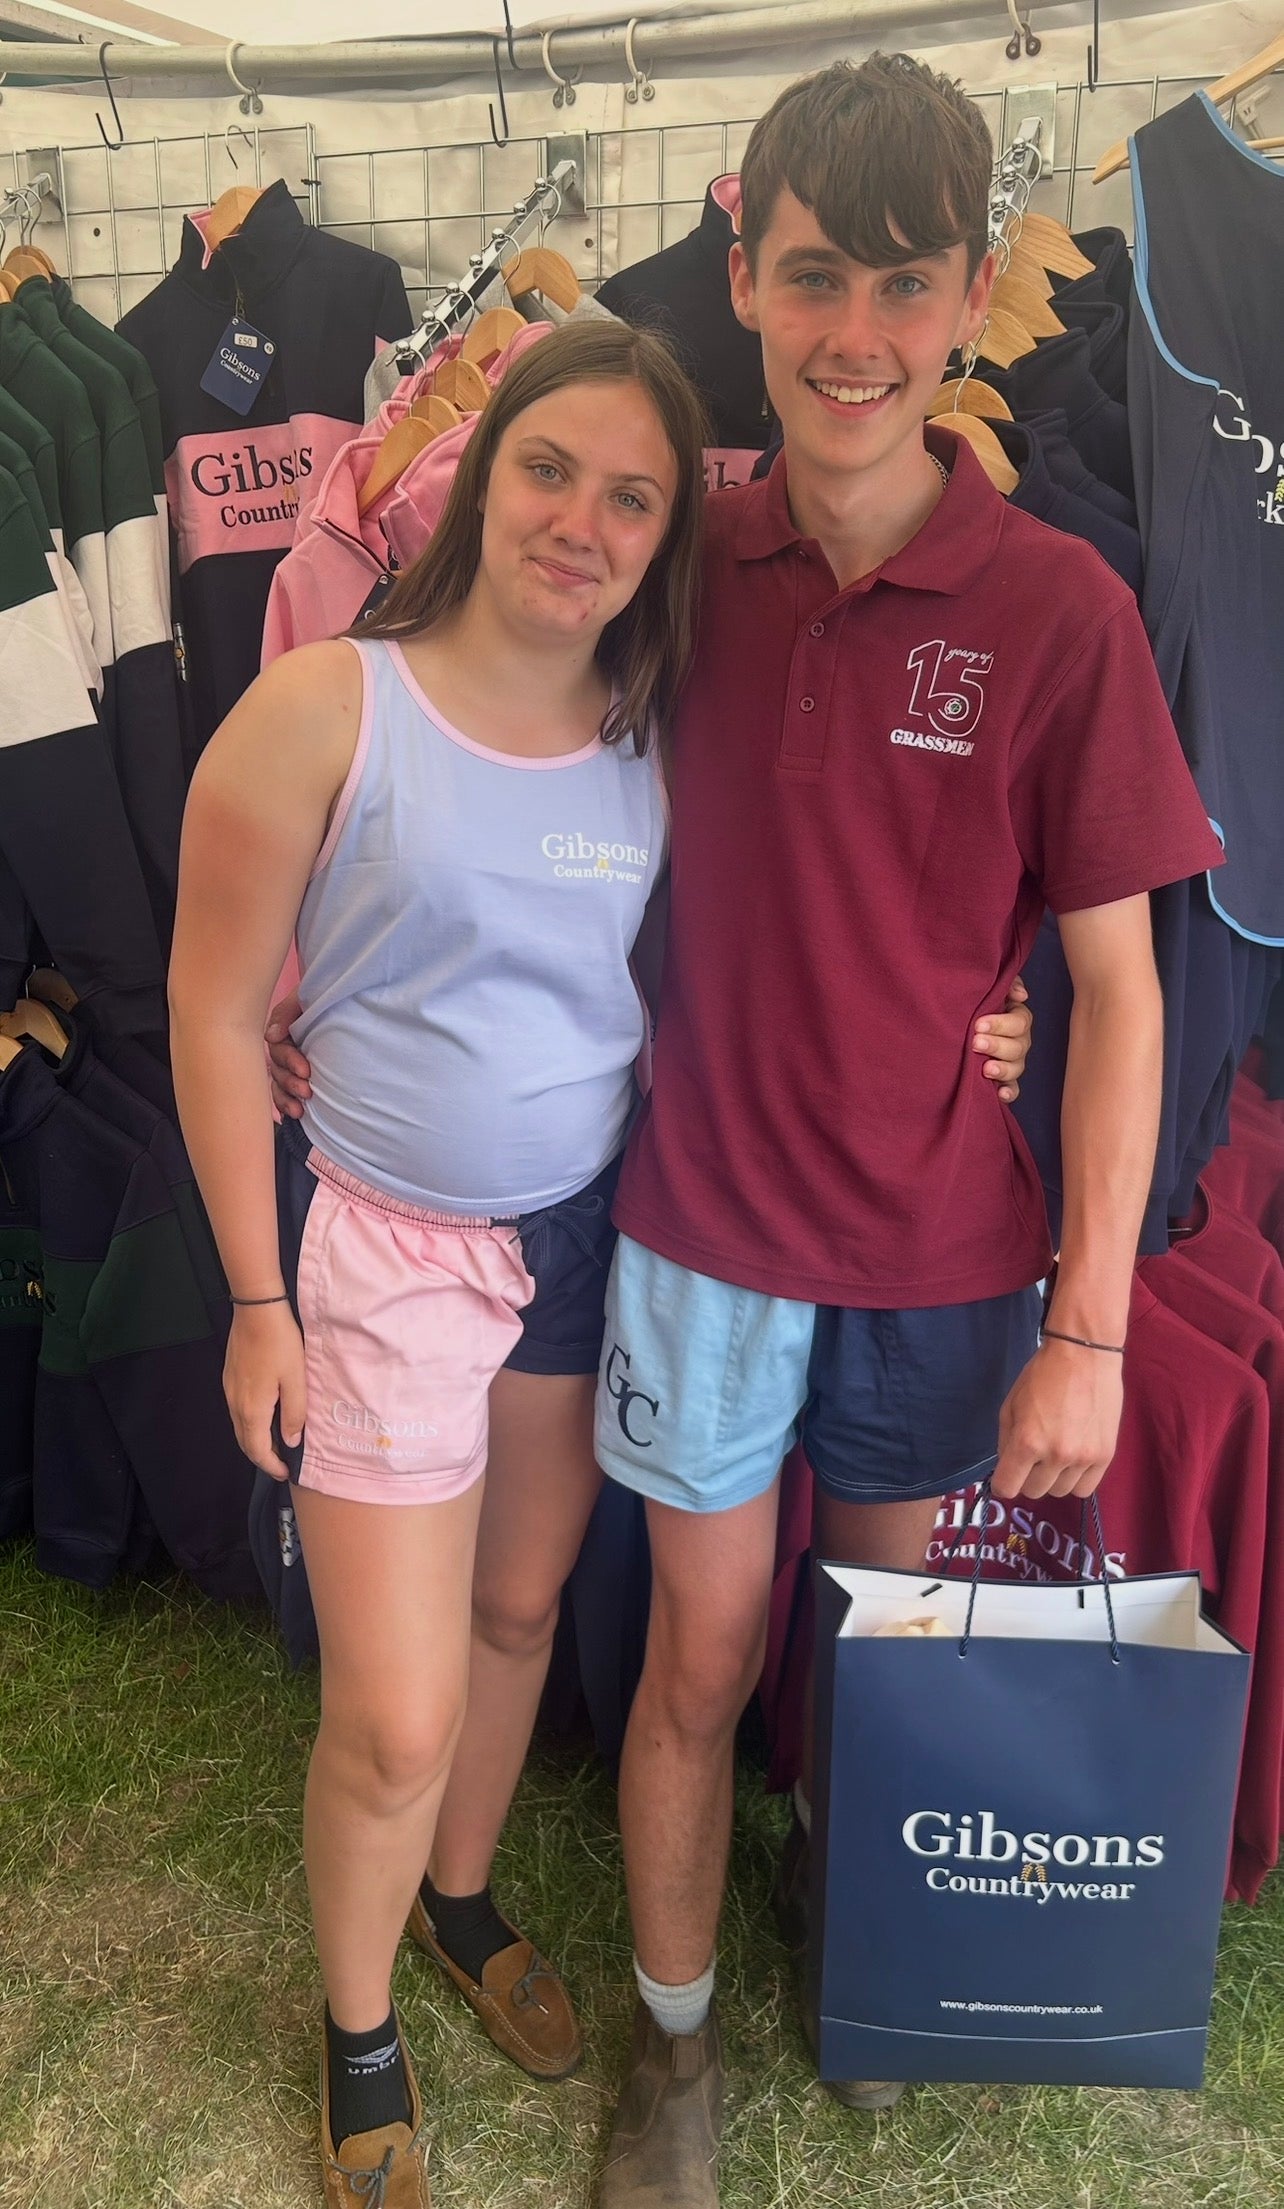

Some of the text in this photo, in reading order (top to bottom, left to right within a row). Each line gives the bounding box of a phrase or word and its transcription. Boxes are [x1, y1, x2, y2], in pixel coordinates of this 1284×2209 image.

[220, 347, 261, 381] Gibsons
[191, 445, 313, 497] Gibss
[944, 648, 994, 665] years of
[907, 639, 994, 738] 15
[890, 728, 975, 757] GRASSMEN
[541, 832, 649, 867] Gibsons
[553, 864, 642, 884] Countrywear
[606, 1342, 660, 1448] GC
[332, 1400, 438, 1438] Gibsons
[933, 1481, 1126, 1580] ibsons
[925, 1540, 1052, 1582] Countryw
[901, 1810, 1165, 1868] Gibsons
[925, 1867, 1136, 1905] Countrywear
[939, 2000, 1103, 2016] www.gibsonscountrywear.co.uk
